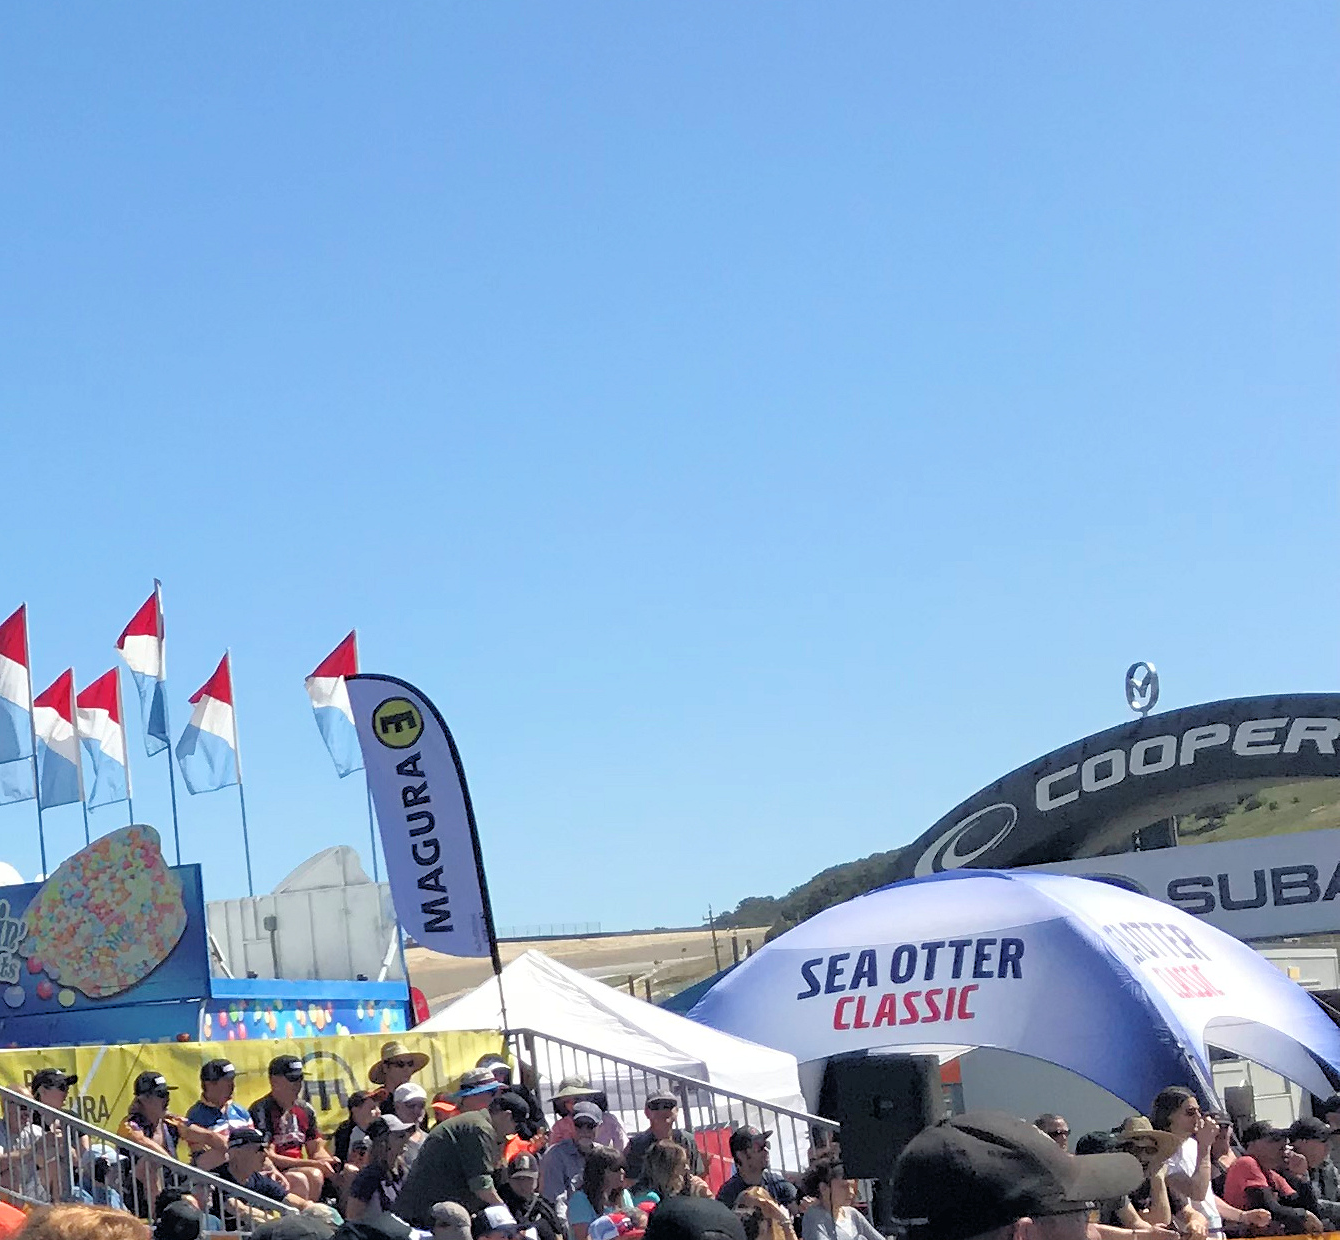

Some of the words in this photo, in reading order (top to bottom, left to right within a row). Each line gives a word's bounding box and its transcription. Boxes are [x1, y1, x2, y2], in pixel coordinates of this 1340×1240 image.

[396, 751, 454, 933] MAGURA
[797, 949, 878, 1000] SEA
[891, 938, 1025, 984] OTTER
[833, 984, 979, 1030] CLASSIC
